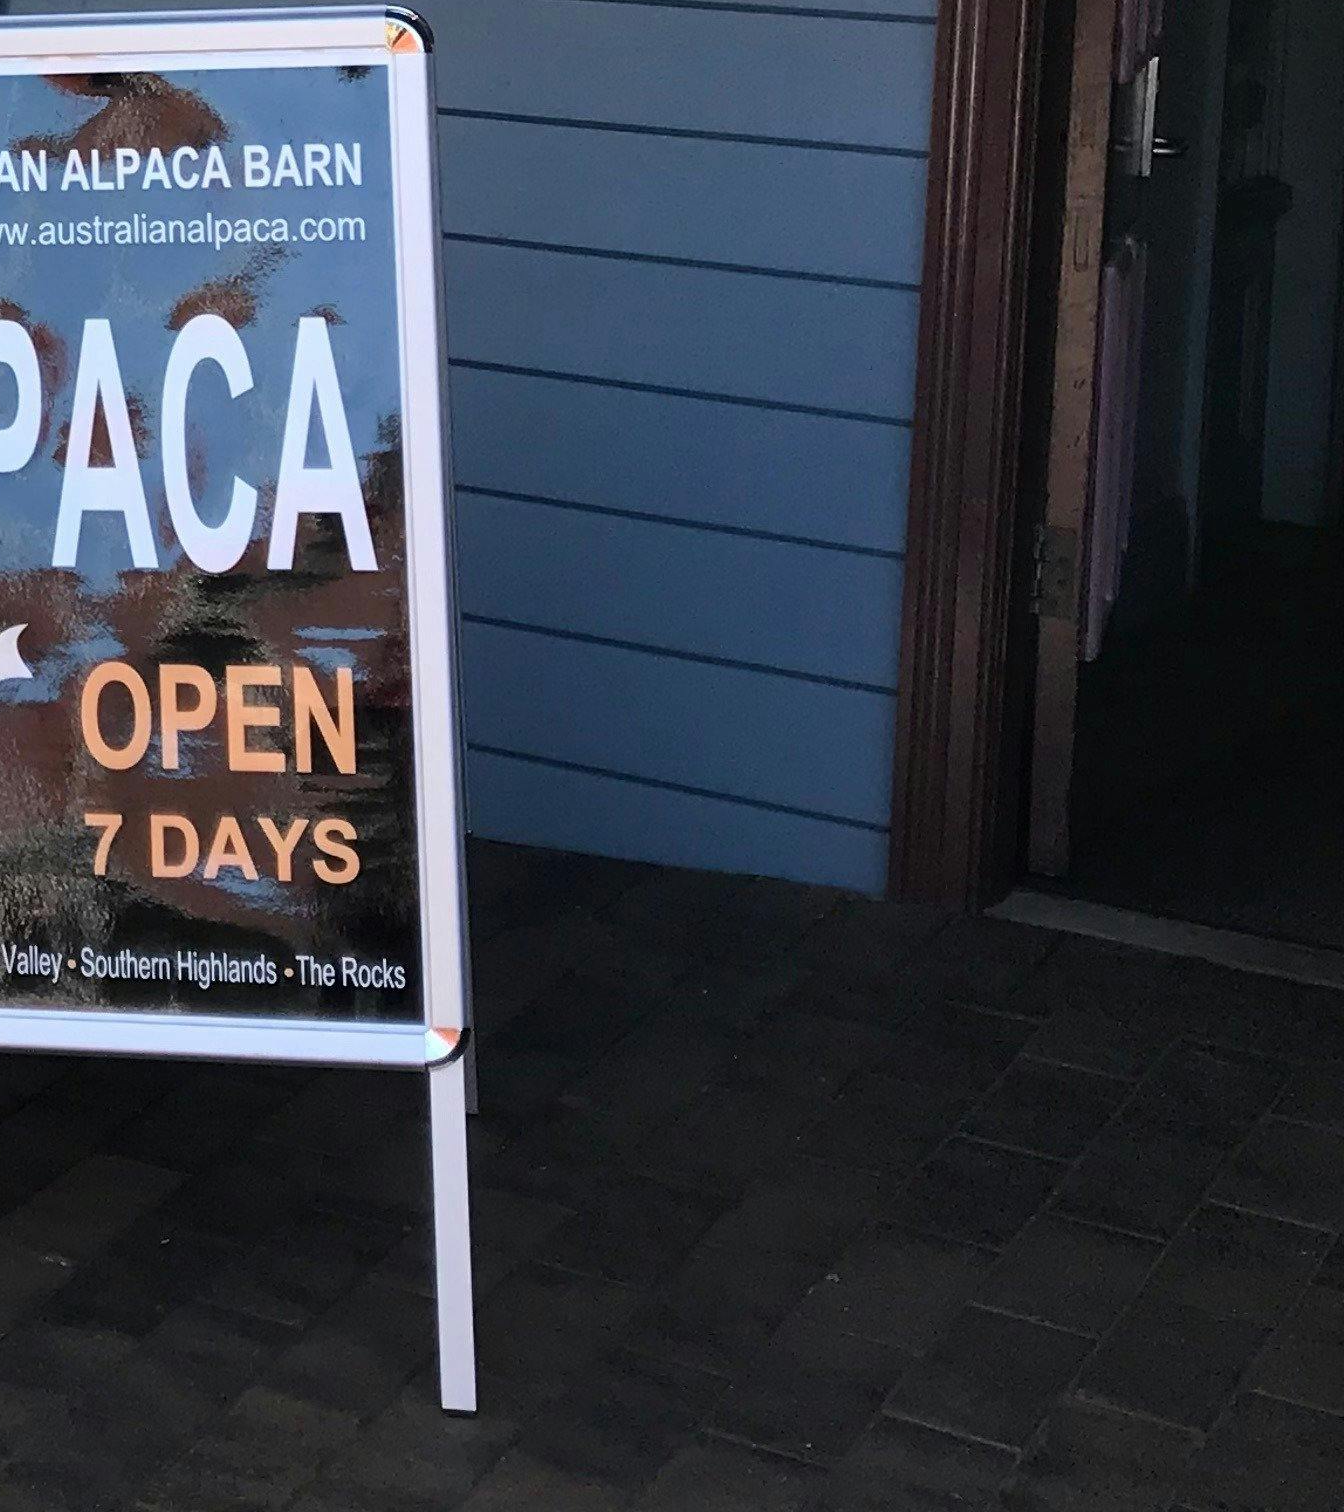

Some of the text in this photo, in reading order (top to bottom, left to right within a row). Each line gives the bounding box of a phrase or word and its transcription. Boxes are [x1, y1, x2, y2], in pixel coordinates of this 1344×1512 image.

[62, 145, 231, 191] ALPACA
[246, 143, 362, 188] BARN
[80, 661, 357, 775] OPEN
[84, 813, 361, 884] 7 DAYS
[1, 944, 63, 984] Valley
[80, 947, 171, 980] Southern
[177, 950, 277, 990] Highlands
[295, 955, 336, 987] The
[341, 956, 407, 989] Rocks
